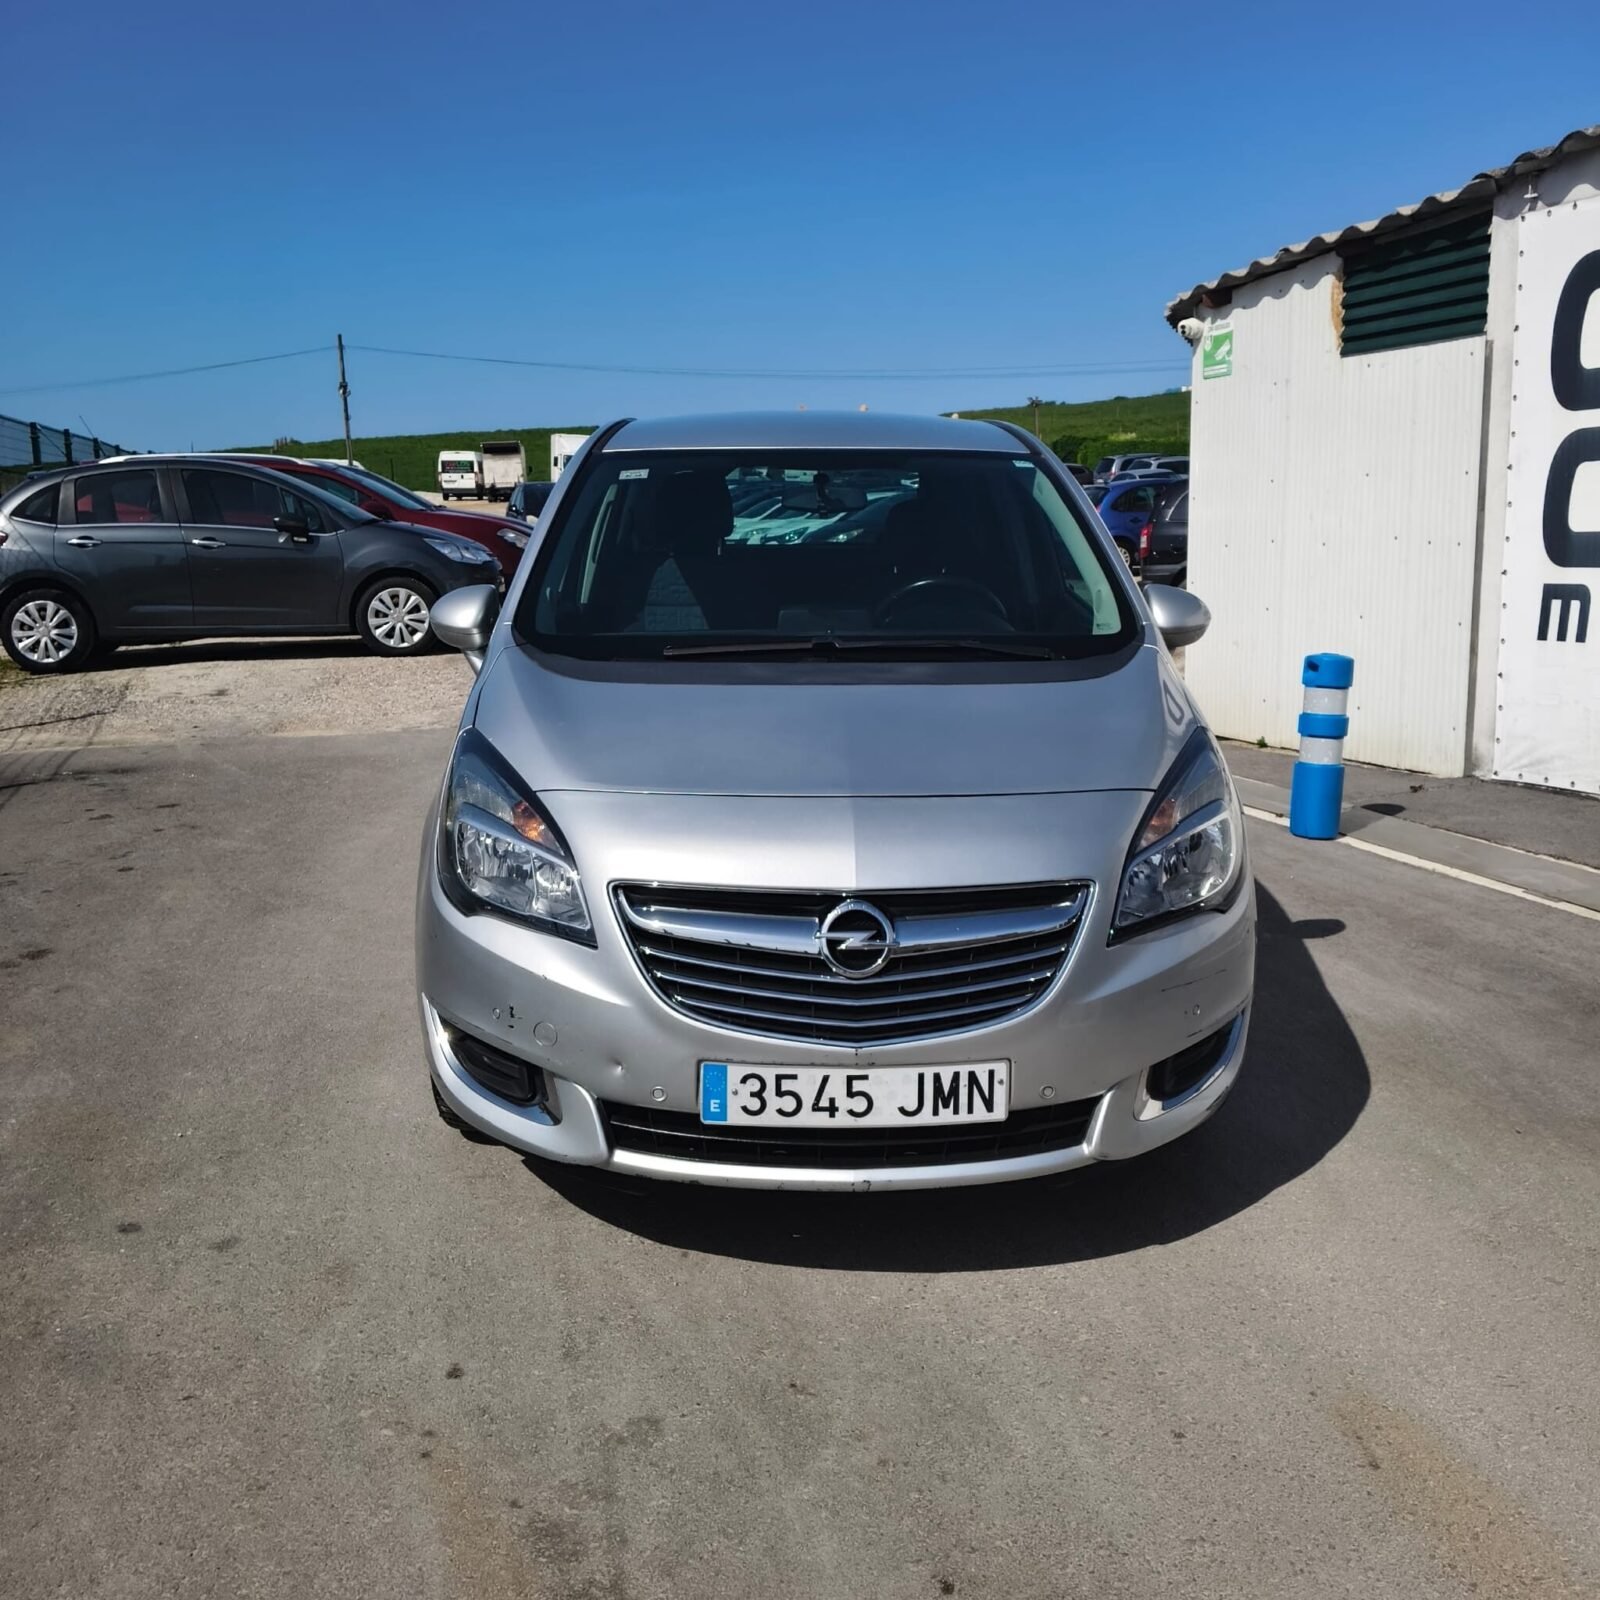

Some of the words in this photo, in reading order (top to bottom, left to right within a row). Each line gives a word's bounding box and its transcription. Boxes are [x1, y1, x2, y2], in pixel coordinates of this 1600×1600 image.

[710, 1100, 721, 1112] E
[739, 1072, 874, 1118] 3545
[897, 1068, 995, 1117] JMN
